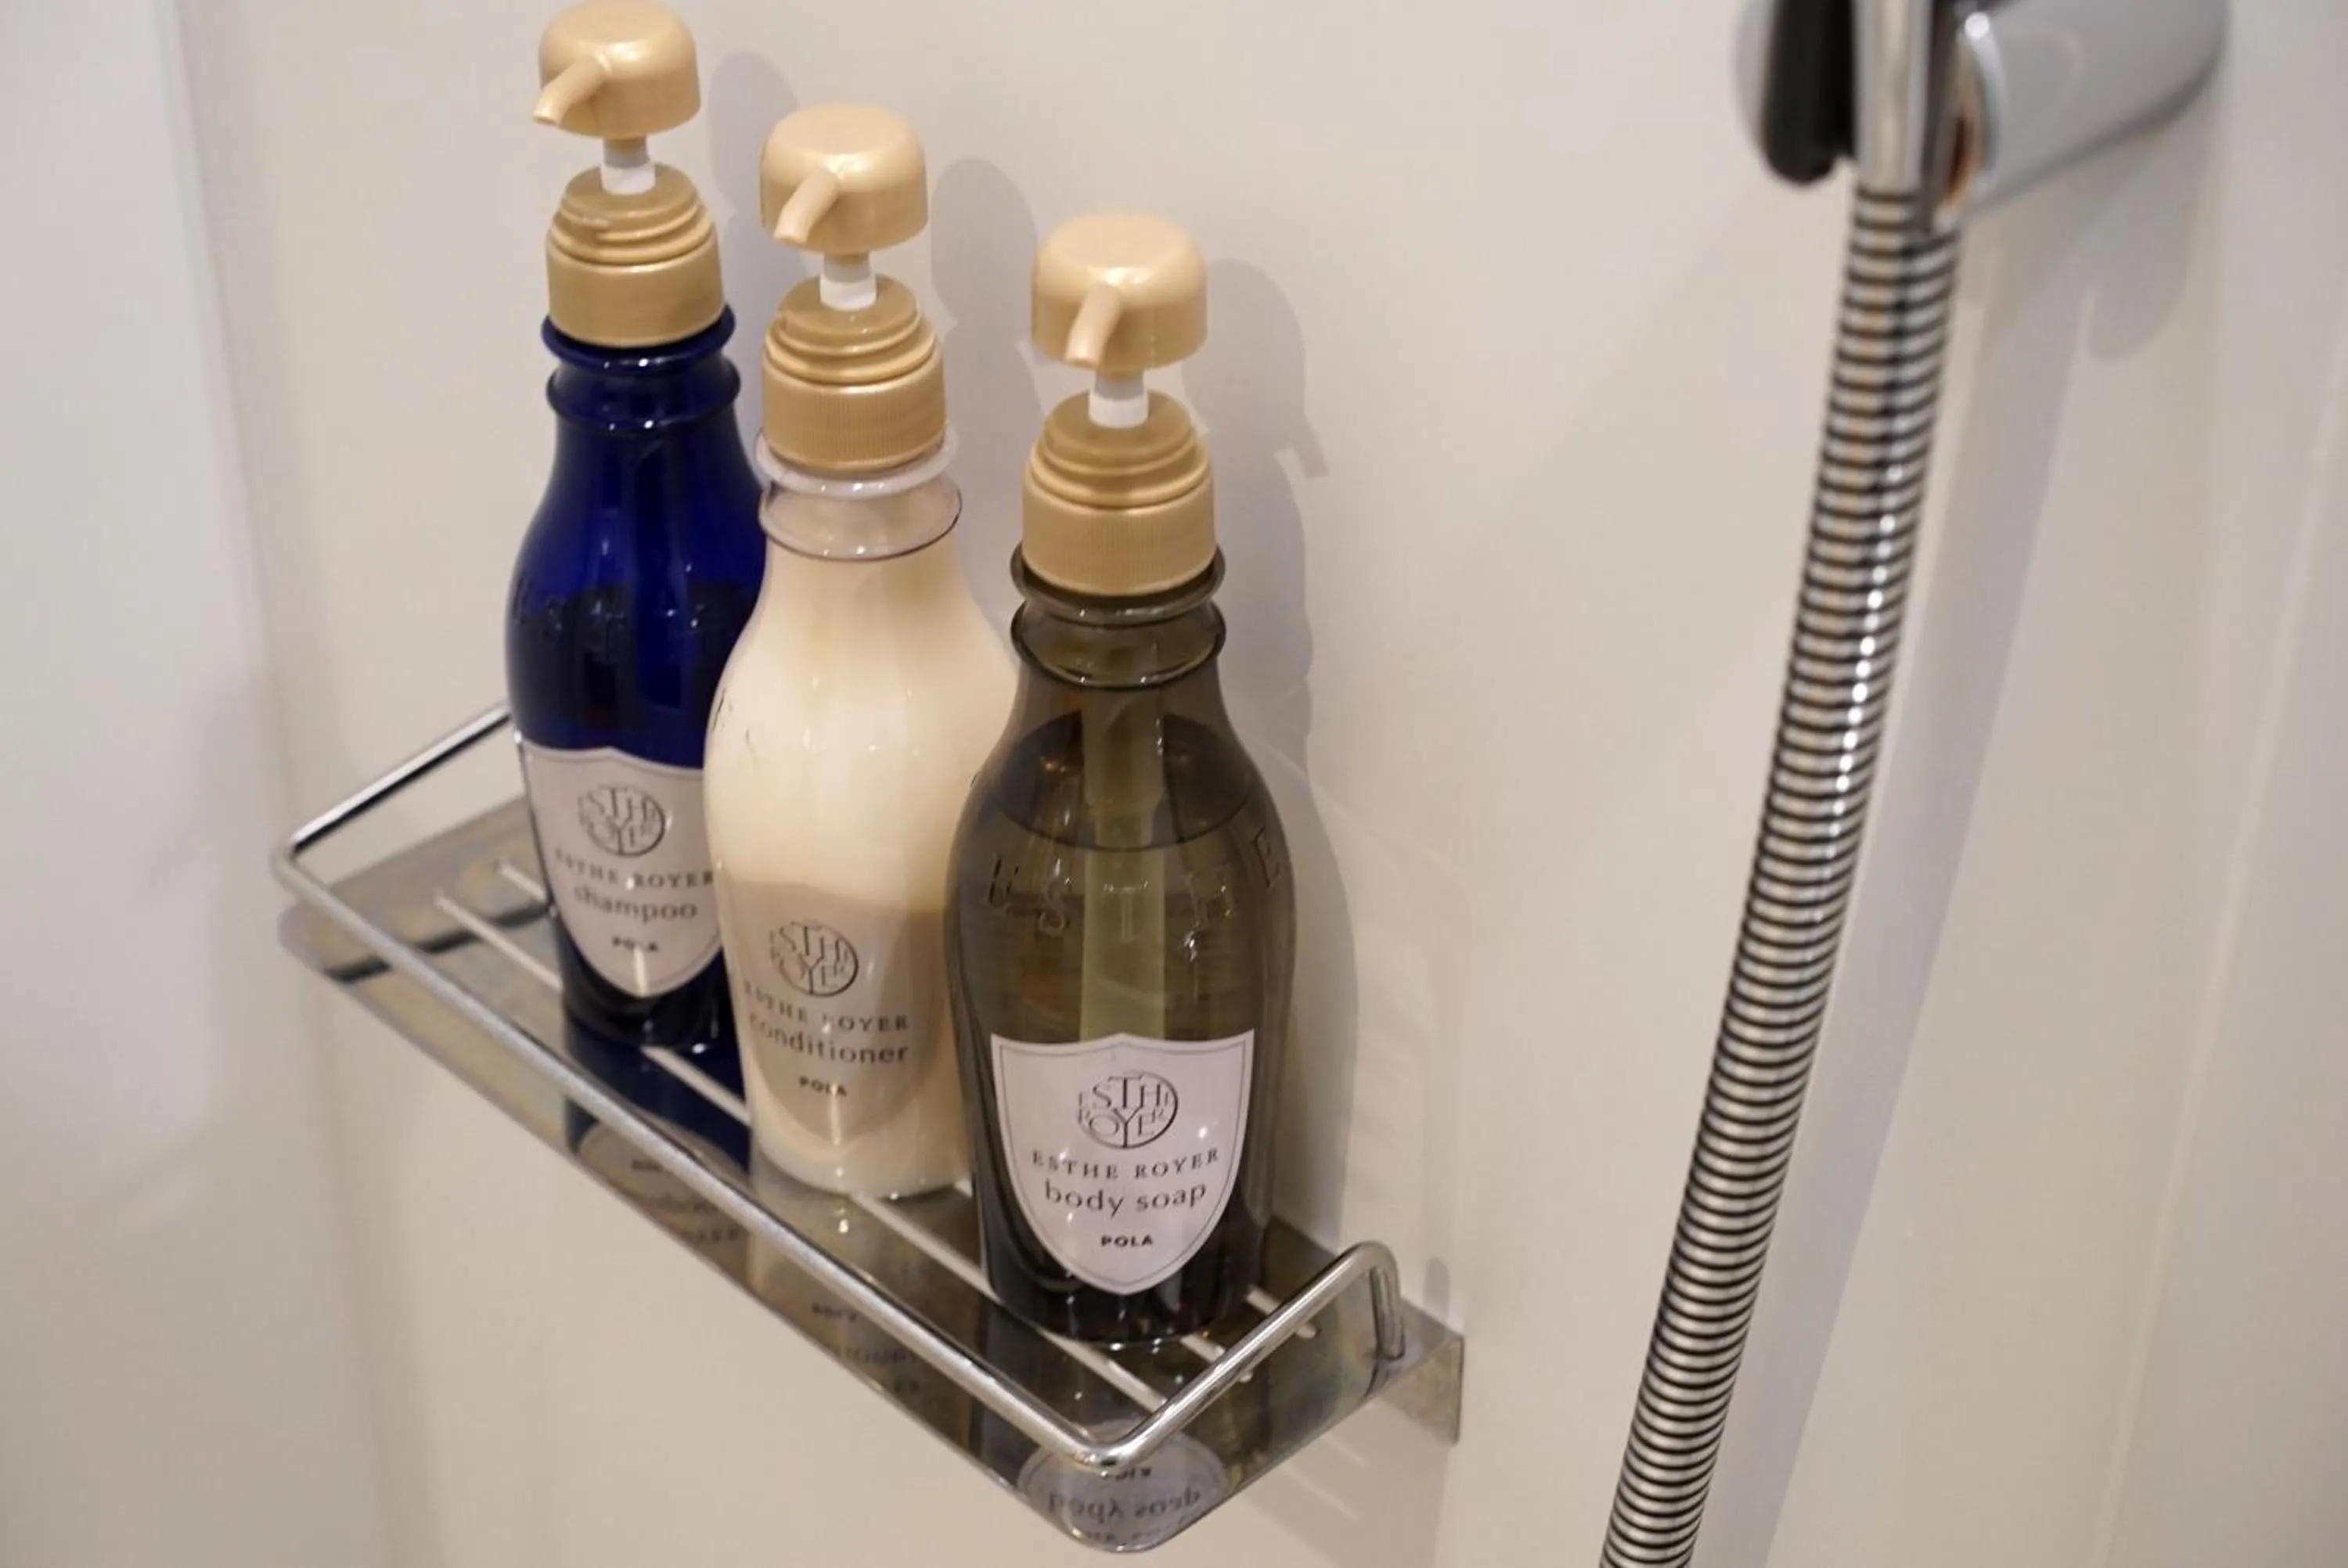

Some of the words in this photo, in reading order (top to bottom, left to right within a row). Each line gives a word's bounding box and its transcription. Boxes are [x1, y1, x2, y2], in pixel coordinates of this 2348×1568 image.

[632, 871, 714, 889] ROYER
[574, 884, 698, 926] shampoo
[611, 935, 661, 953] POA
[750, 1013, 909, 1065] conditioner
[1032, 1149, 1118, 1179] ESTHE
[1134, 1147, 1219, 1179] ROYER
[1045, 1178, 1124, 1218] body
[1136, 1183, 1207, 1210] soap
[1100, 1234, 1154, 1247] POLA
